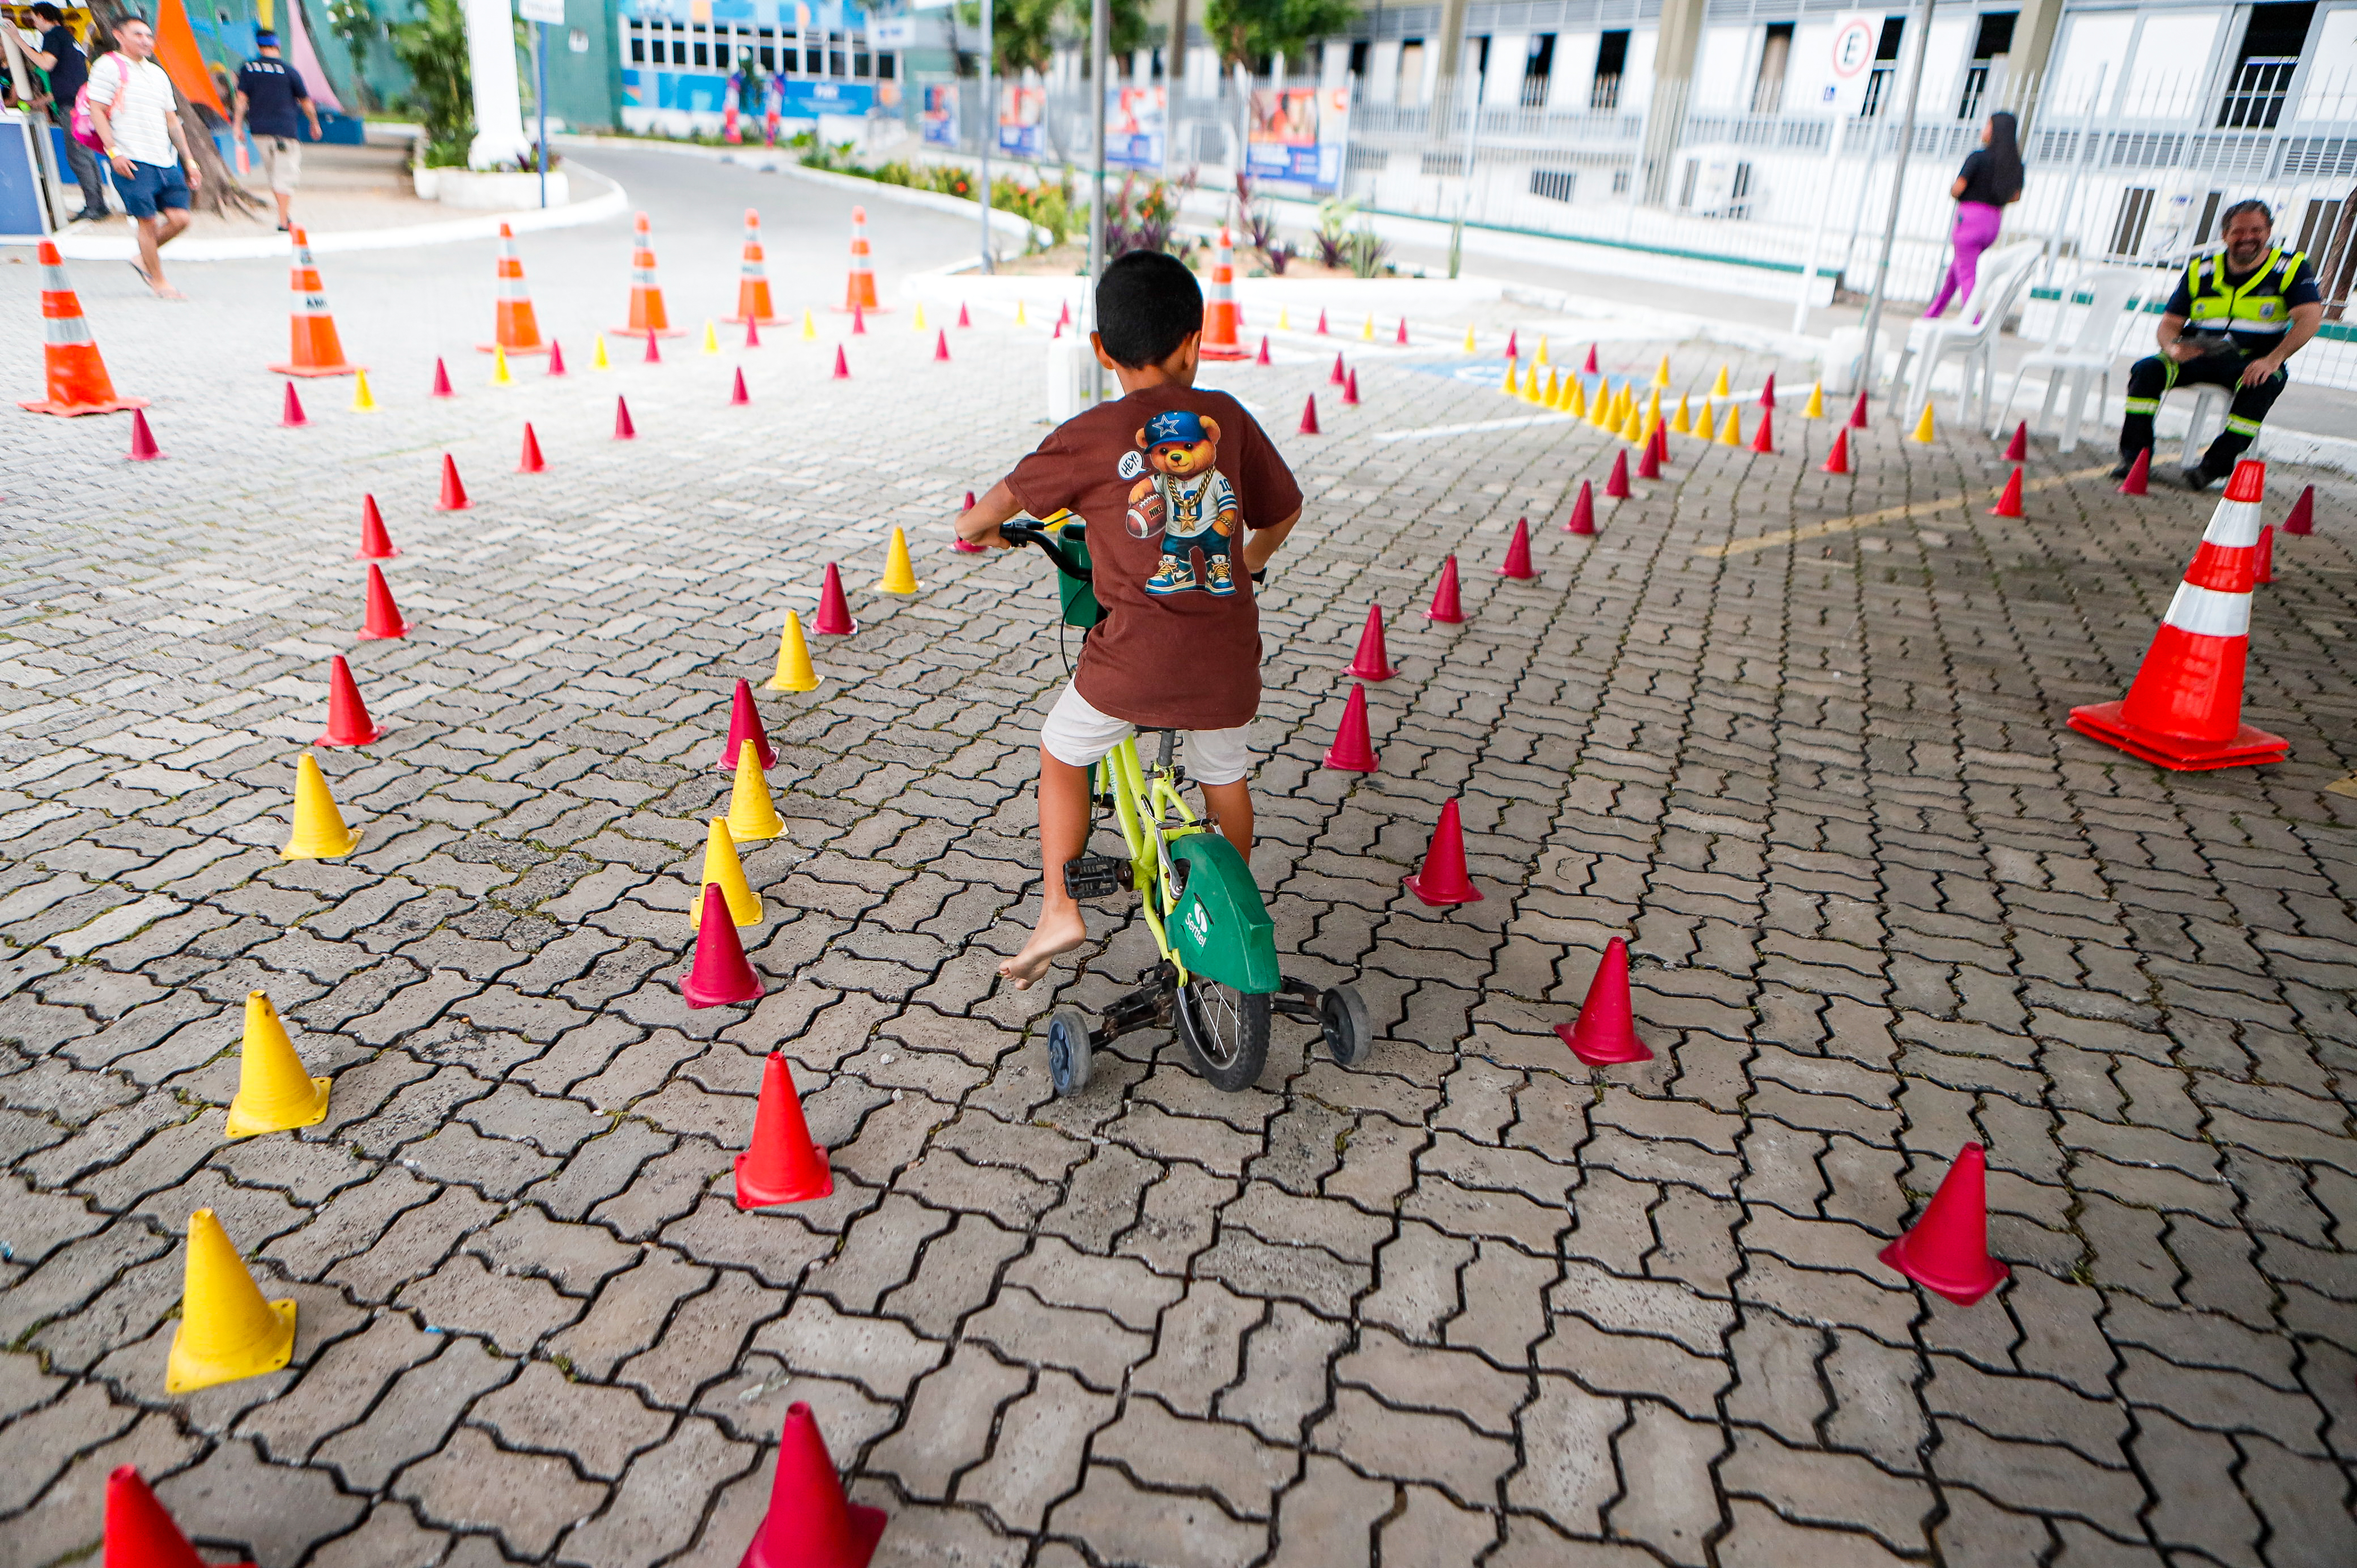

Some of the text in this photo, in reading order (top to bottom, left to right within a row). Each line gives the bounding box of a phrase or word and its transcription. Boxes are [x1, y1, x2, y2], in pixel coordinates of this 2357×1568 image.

[1844, 33, 1860, 65] E
[1121, 453, 1139, 476] HEY!
[1219, 478, 1232, 493] 10
[1149, 505, 1162, 518] NIKE
[1106, 756, 1117, 801] Fortaleza
[1185, 912, 1206, 947] Serttel
